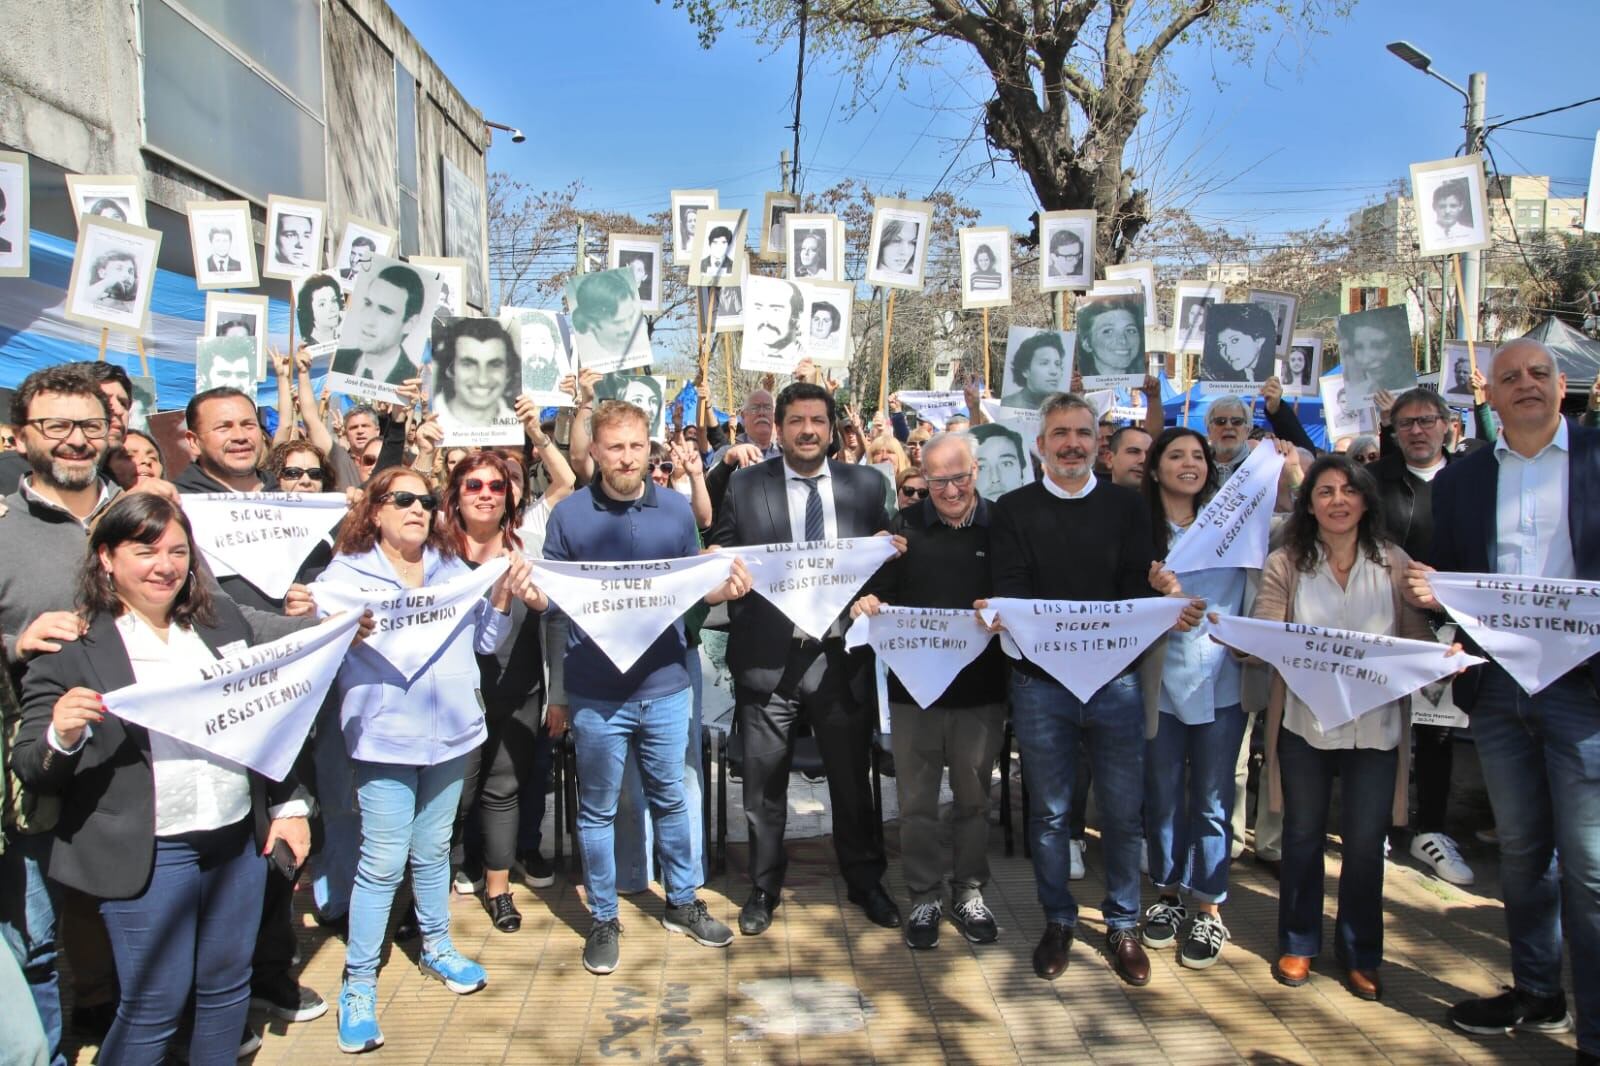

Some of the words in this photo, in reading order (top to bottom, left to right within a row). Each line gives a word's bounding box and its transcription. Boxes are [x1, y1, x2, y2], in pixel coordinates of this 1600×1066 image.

[1216, 487, 1267, 558] RESISTIENDO
[214, 526, 309, 548] RESISTIENDO
[769, 574, 857, 593] RESISTIENDO
[582, 595, 676, 614] RESISTIENDO
[372, 605, 456, 635] SISTIENDO
[880, 636, 967, 650] RESISTIENDO
[1034, 636, 1138, 654] RESISTIENDO
[1282, 655, 1388, 686] RESISTIENDO
[205, 679, 312, 735] RESISTIENDO
